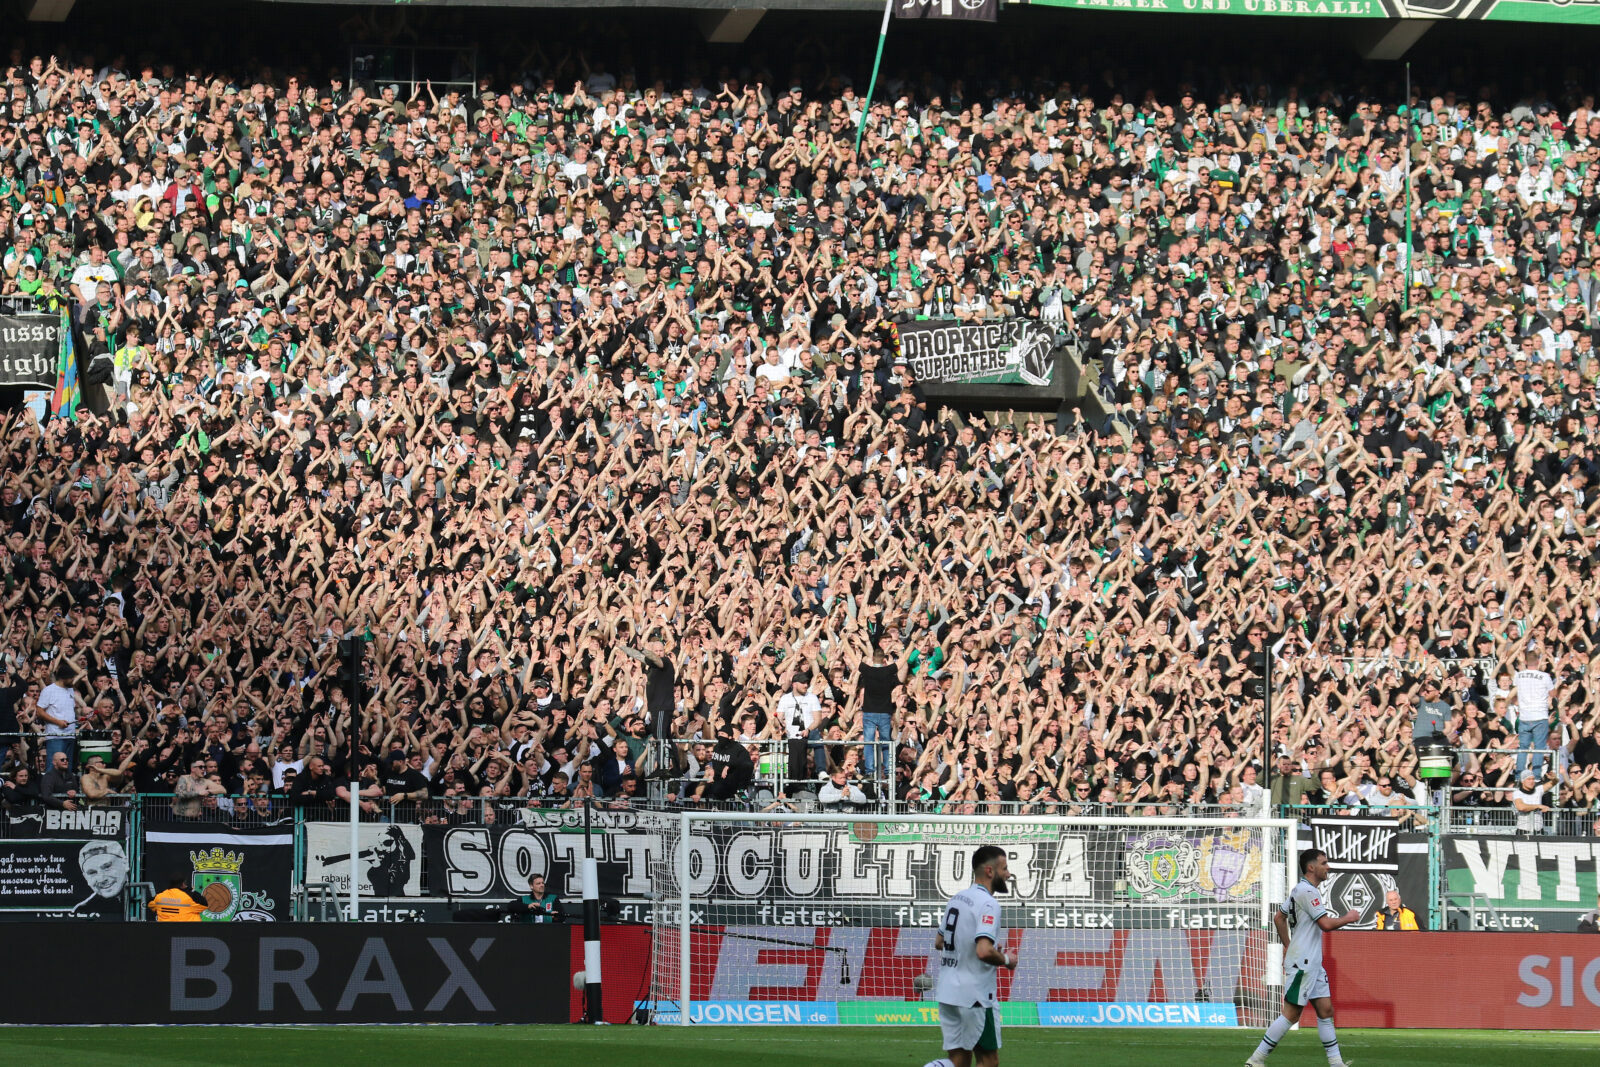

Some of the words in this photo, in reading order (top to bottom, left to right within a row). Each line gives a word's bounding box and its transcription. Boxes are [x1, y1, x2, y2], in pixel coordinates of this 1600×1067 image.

[1185, 0, 1230, 11] UND
[2, 323, 60, 343] usse
[914, 350, 1007, 382] SUPPORTERS
[46, 809, 121, 830] BANDA
[526, 811, 711, 832] ASCENDENE
[92, 826, 118, 836] SUD
[0, 853, 15, 866] gal
[0, 864, 13, 874] nd
[444, 827, 1094, 899] SOTTOCULTURA
[321, 874, 351, 883] rabauk
[1453, 839, 1600, 902] VIT
[895, 906, 944, 926] flat
[943, 907, 960, 951] 9
[170, 937, 496, 1011] BRAX
[690, 1004, 800, 1022] JONGEN
[1051, 1013, 1088, 1024] www.
[1092, 1005, 1201, 1023] JONGEN
